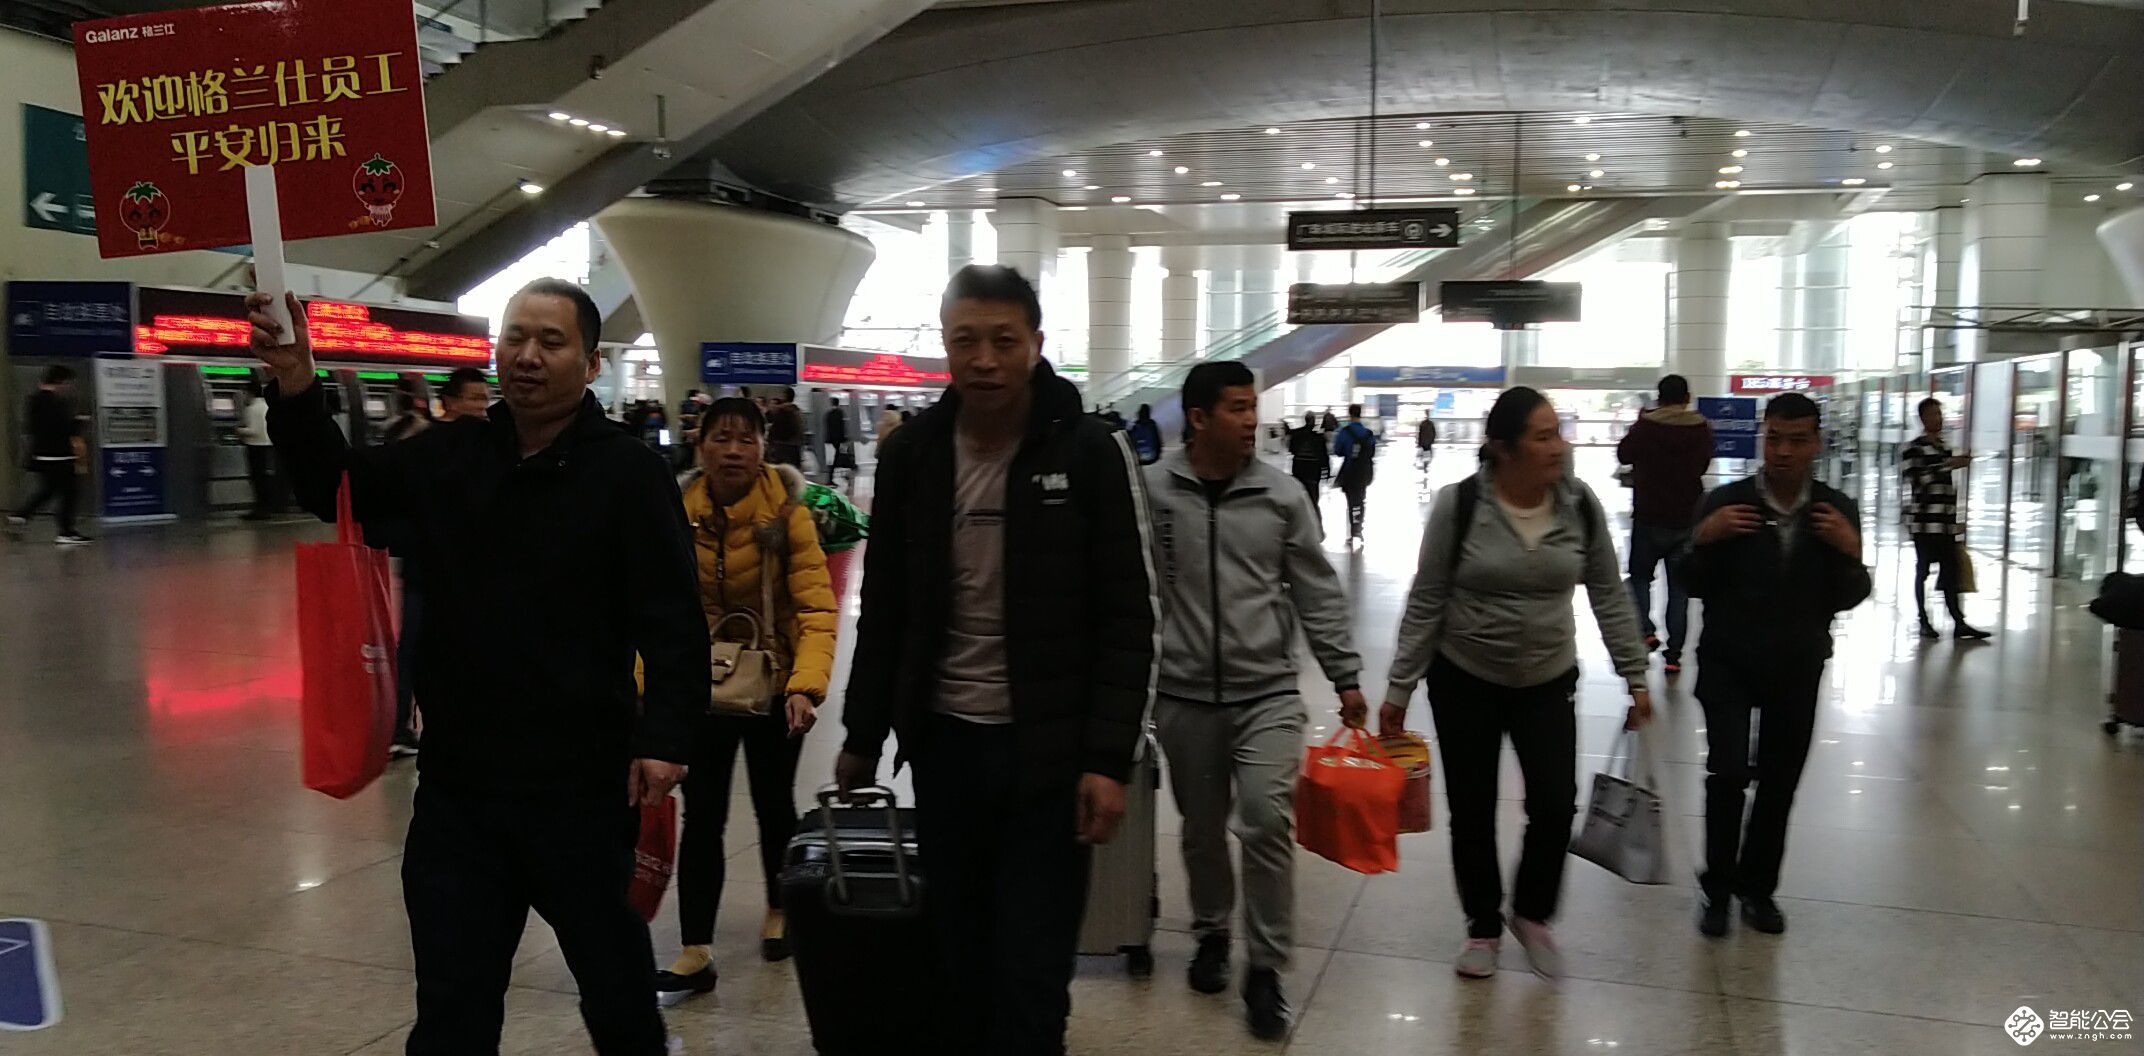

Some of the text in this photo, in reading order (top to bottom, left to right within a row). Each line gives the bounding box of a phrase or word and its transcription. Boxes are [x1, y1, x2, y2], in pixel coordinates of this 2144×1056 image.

[85, 27, 139, 43] Galanz
[96, 52, 408, 126] 欢迎格兰仕员工
[171, 114, 347, 175] 平安归来
